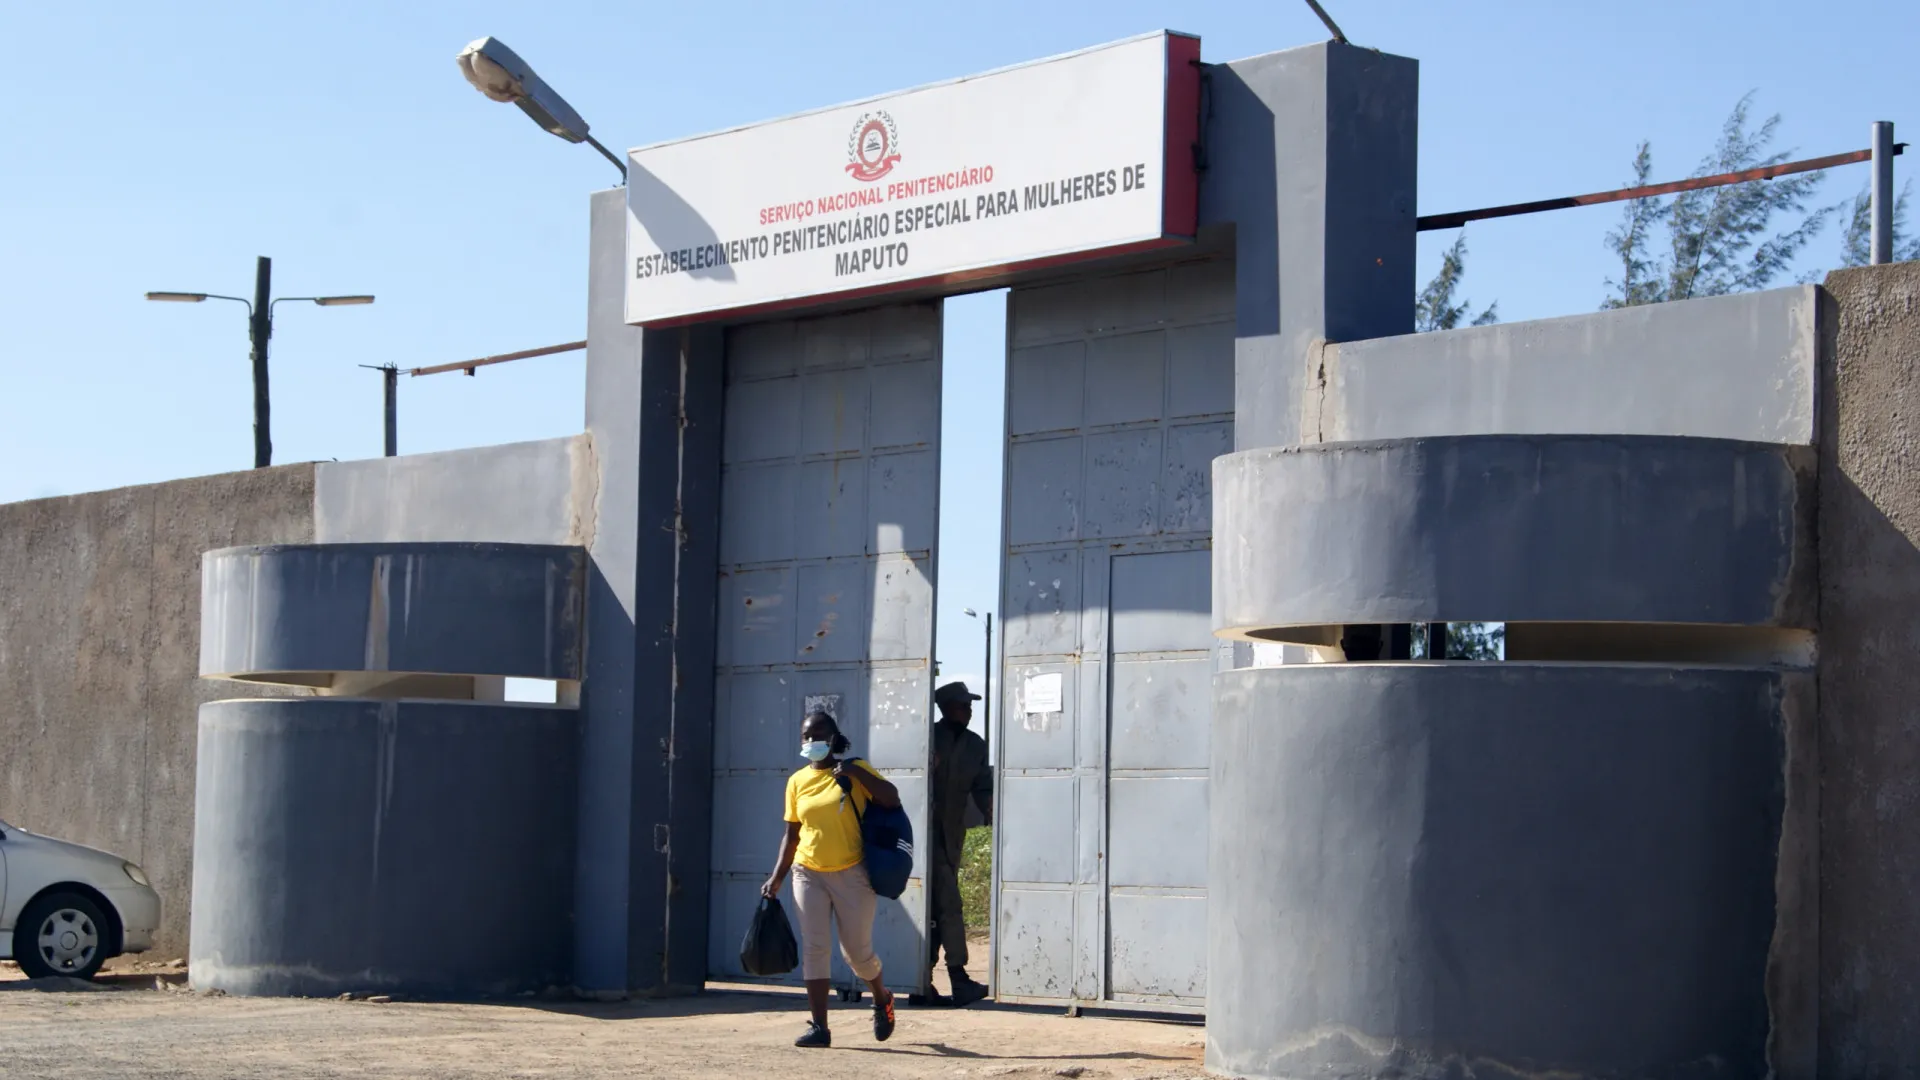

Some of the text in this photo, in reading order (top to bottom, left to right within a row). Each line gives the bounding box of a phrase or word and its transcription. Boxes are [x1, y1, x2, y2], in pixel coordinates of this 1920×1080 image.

[636, 163, 1145, 279] ESTABELECIMENTO PENITENCIÁRIO ESPECIAL PARA MULHERES DE
[760, 165, 993, 225] SERVIÇO NACIONAL PENITENCIÁRIO
[835, 242, 908, 277] MAPUTO
